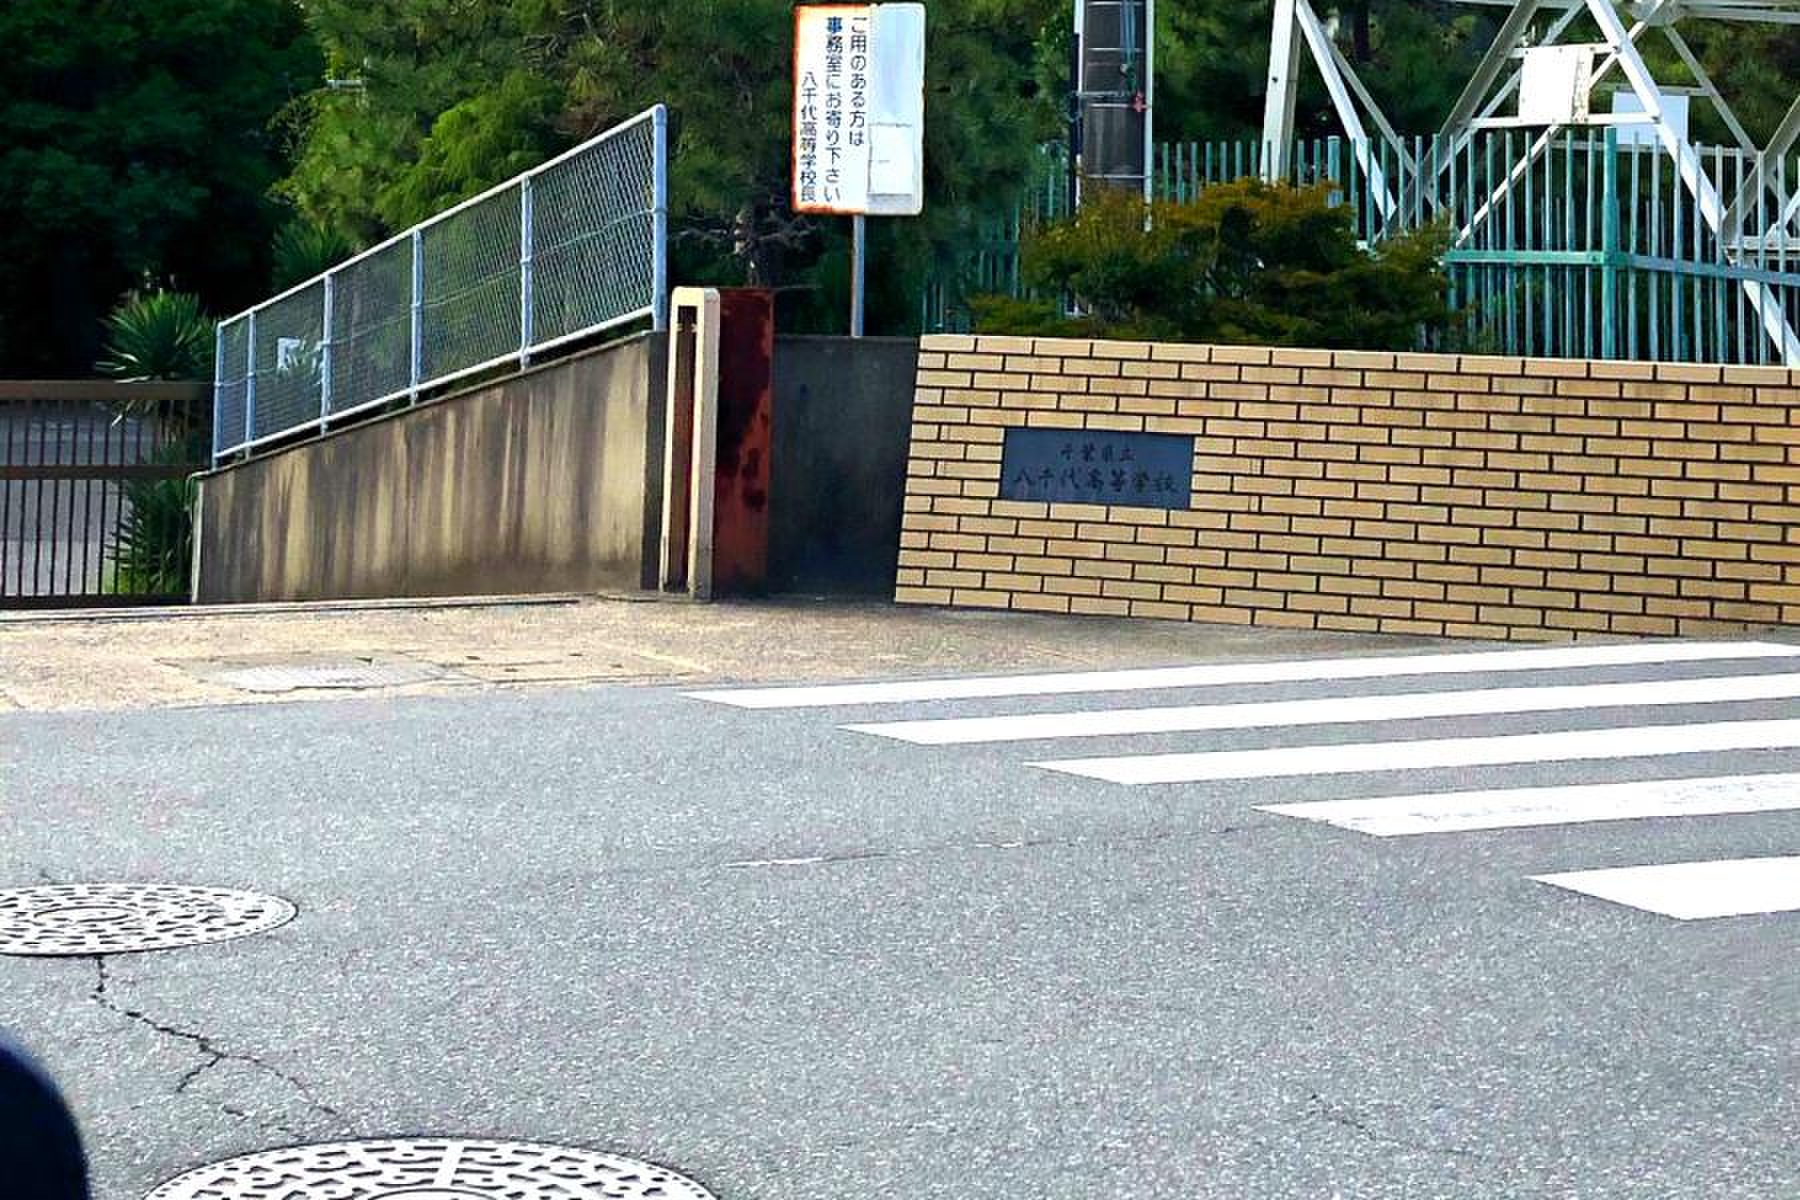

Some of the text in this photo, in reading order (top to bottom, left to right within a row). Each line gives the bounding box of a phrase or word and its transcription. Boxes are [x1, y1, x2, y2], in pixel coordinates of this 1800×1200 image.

[824, 16, 843, 202] 事務室にお寄り下さい
